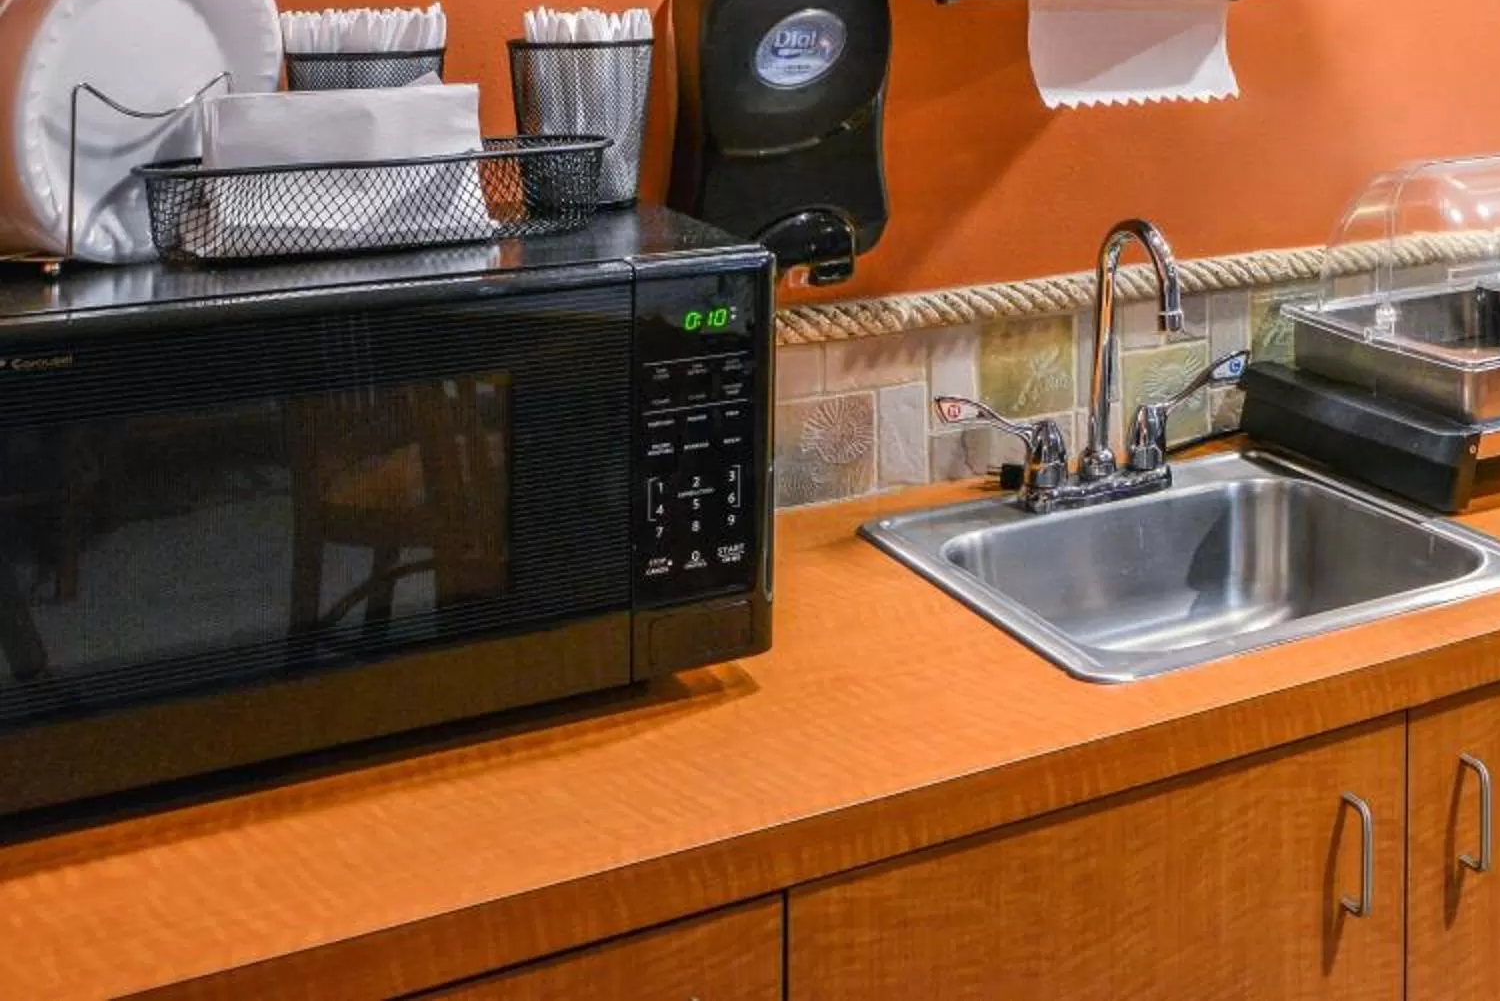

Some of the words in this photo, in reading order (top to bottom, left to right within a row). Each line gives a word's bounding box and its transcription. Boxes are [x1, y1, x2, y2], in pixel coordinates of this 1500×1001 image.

[774, 30, 817, 48] Dial
[684, 308, 728, 331] 0:10
[692, 476, 701, 488] 2
[728, 470, 736, 482] 3
[658, 482, 664, 495] 1
[692, 498, 701, 510] 5
[727, 492, 736, 504] 6
[655, 504, 665, 515] 4
[691, 520, 701, 532] 8
[727, 514, 736, 526] 9
[655, 526, 664, 539] 7
[691, 550, 700, 562] 0
